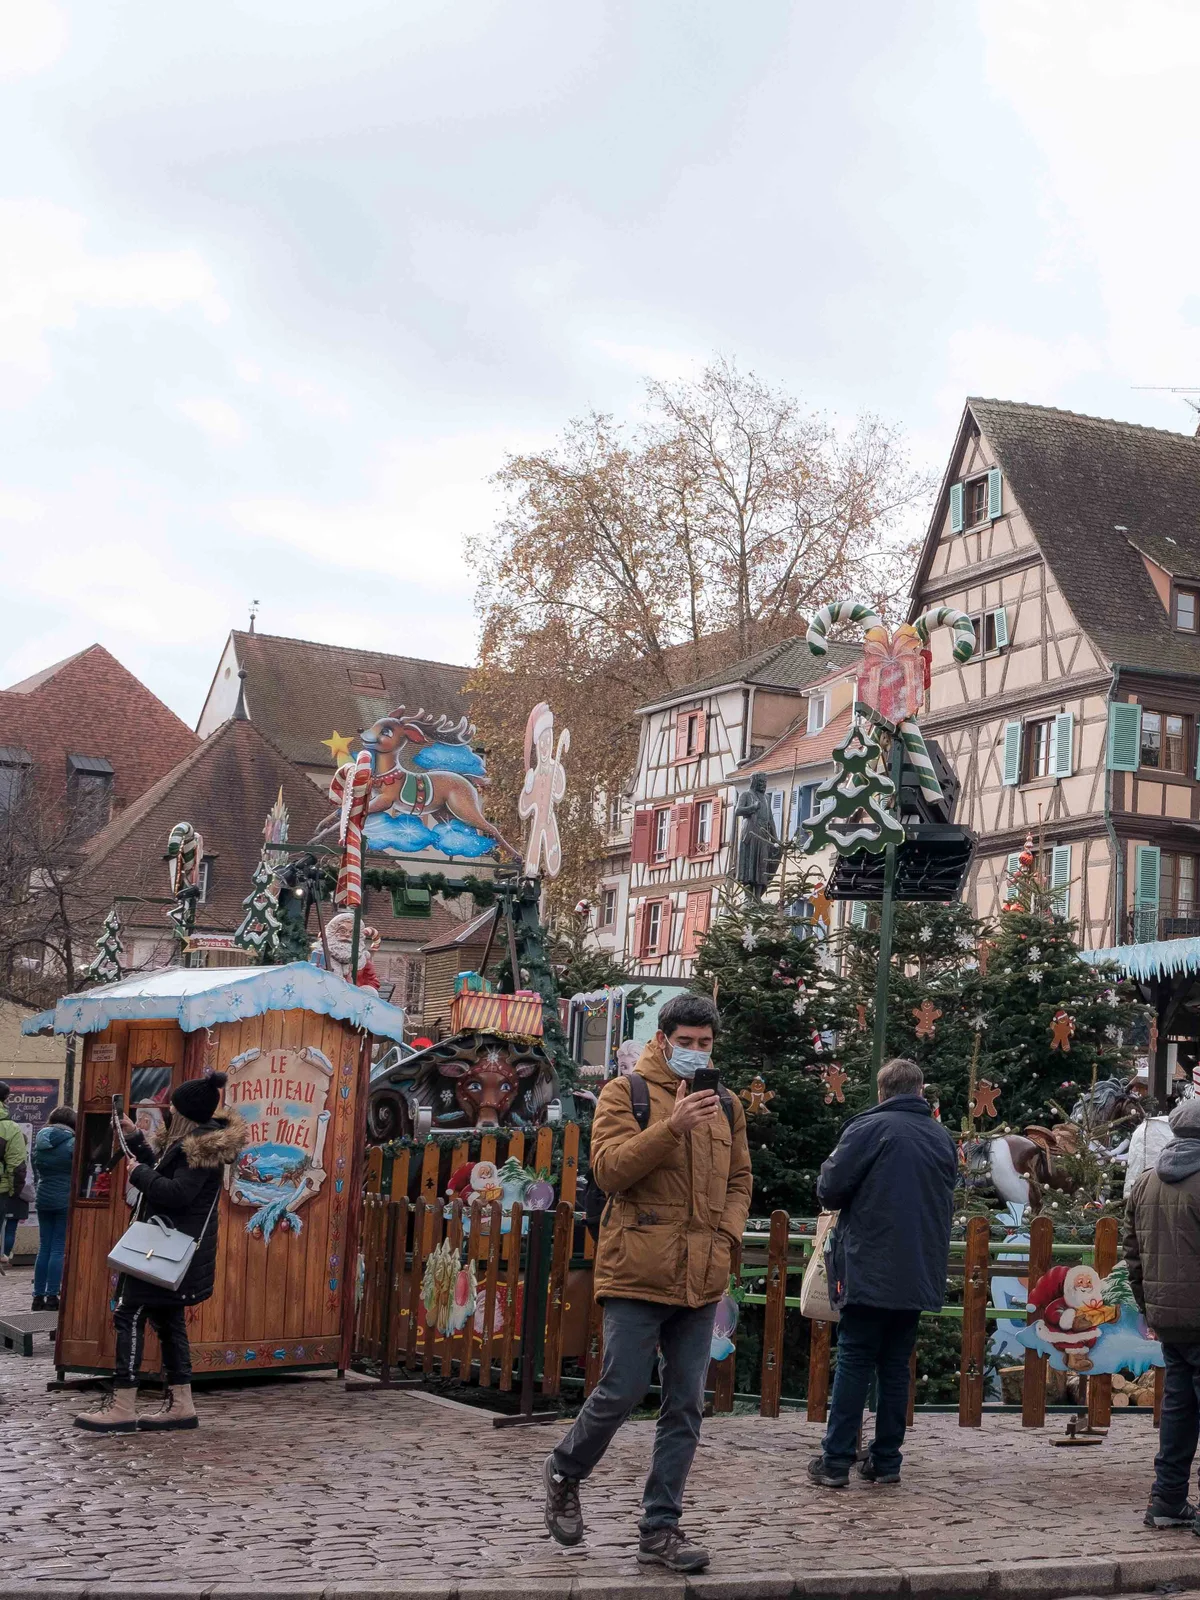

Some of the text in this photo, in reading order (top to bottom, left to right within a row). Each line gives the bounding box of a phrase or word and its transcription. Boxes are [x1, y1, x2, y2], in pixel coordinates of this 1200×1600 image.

[197, 940, 226, 948] Joyeux
[271, 1055, 287, 1074] LE
[7, 1093, 48, 1104] Colmar
[230, 1078, 315, 1103] TRAINEAU
[266, 1101, 280, 1116] du
[275, 1118, 310, 1148] NOËL
